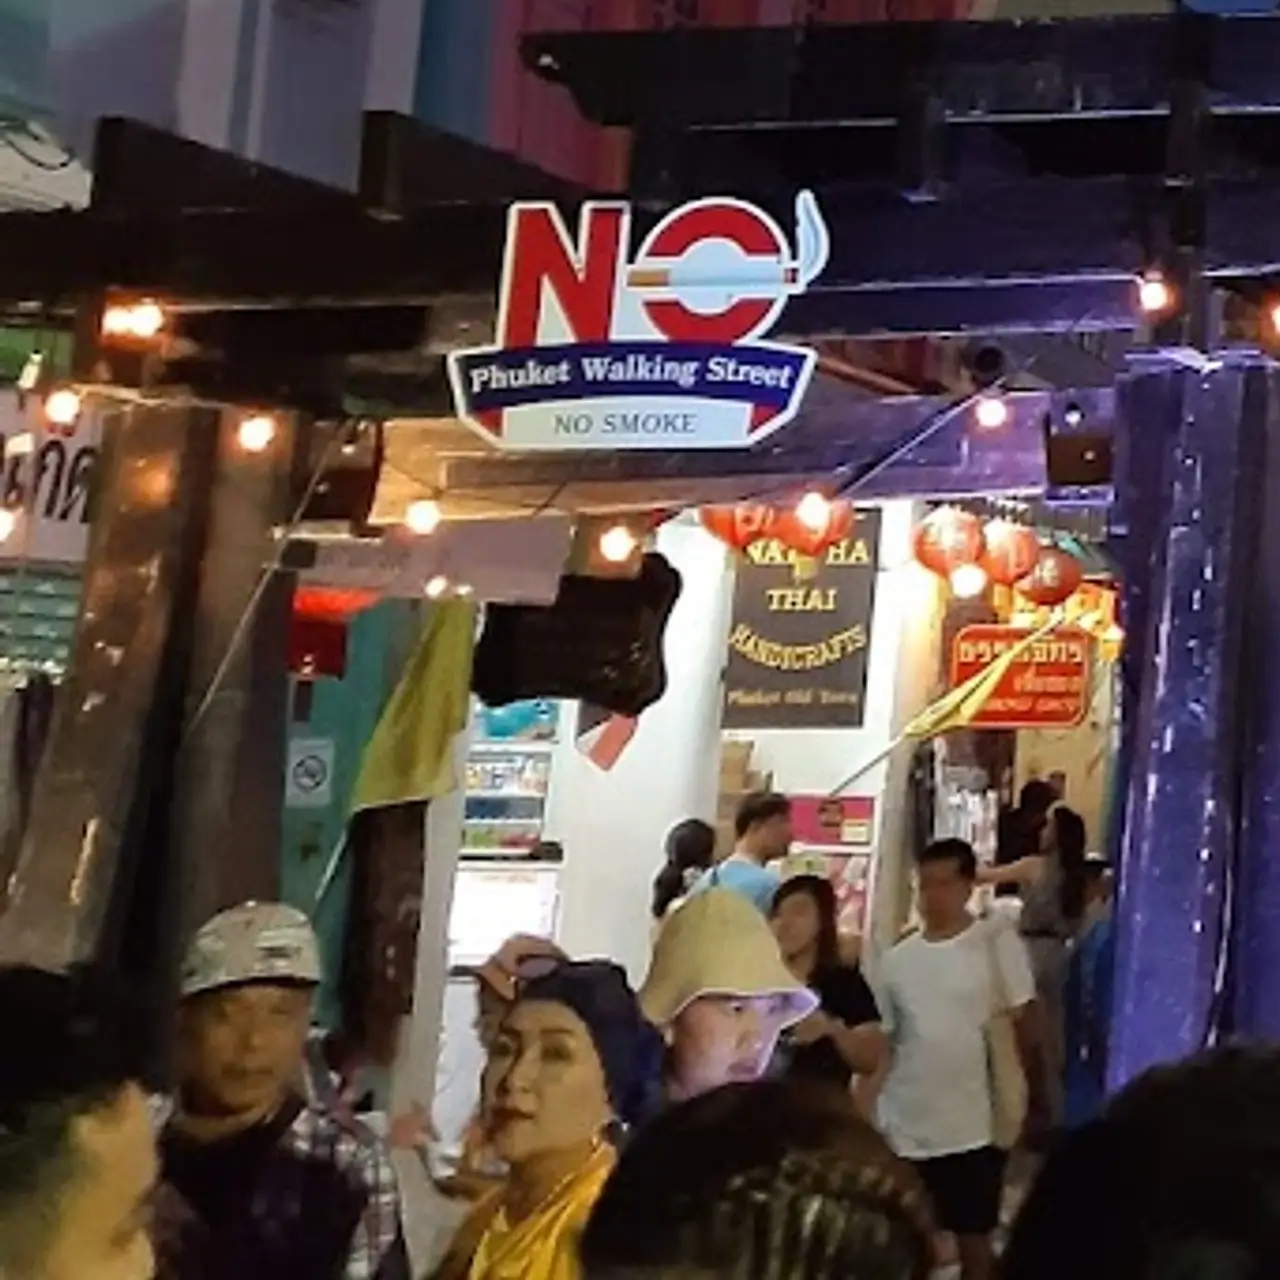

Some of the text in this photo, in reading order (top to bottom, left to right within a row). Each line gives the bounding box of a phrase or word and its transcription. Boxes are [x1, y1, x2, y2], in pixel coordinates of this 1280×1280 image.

[500, 202, 788, 346] NO
[469, 353, 792, 392] Phuket Walking Street
[553, 413, 697, 435] NO SMOKE
[766, 588, 838, 612] THAI
[728, 623, 867, 672] HANDICRAFTS
